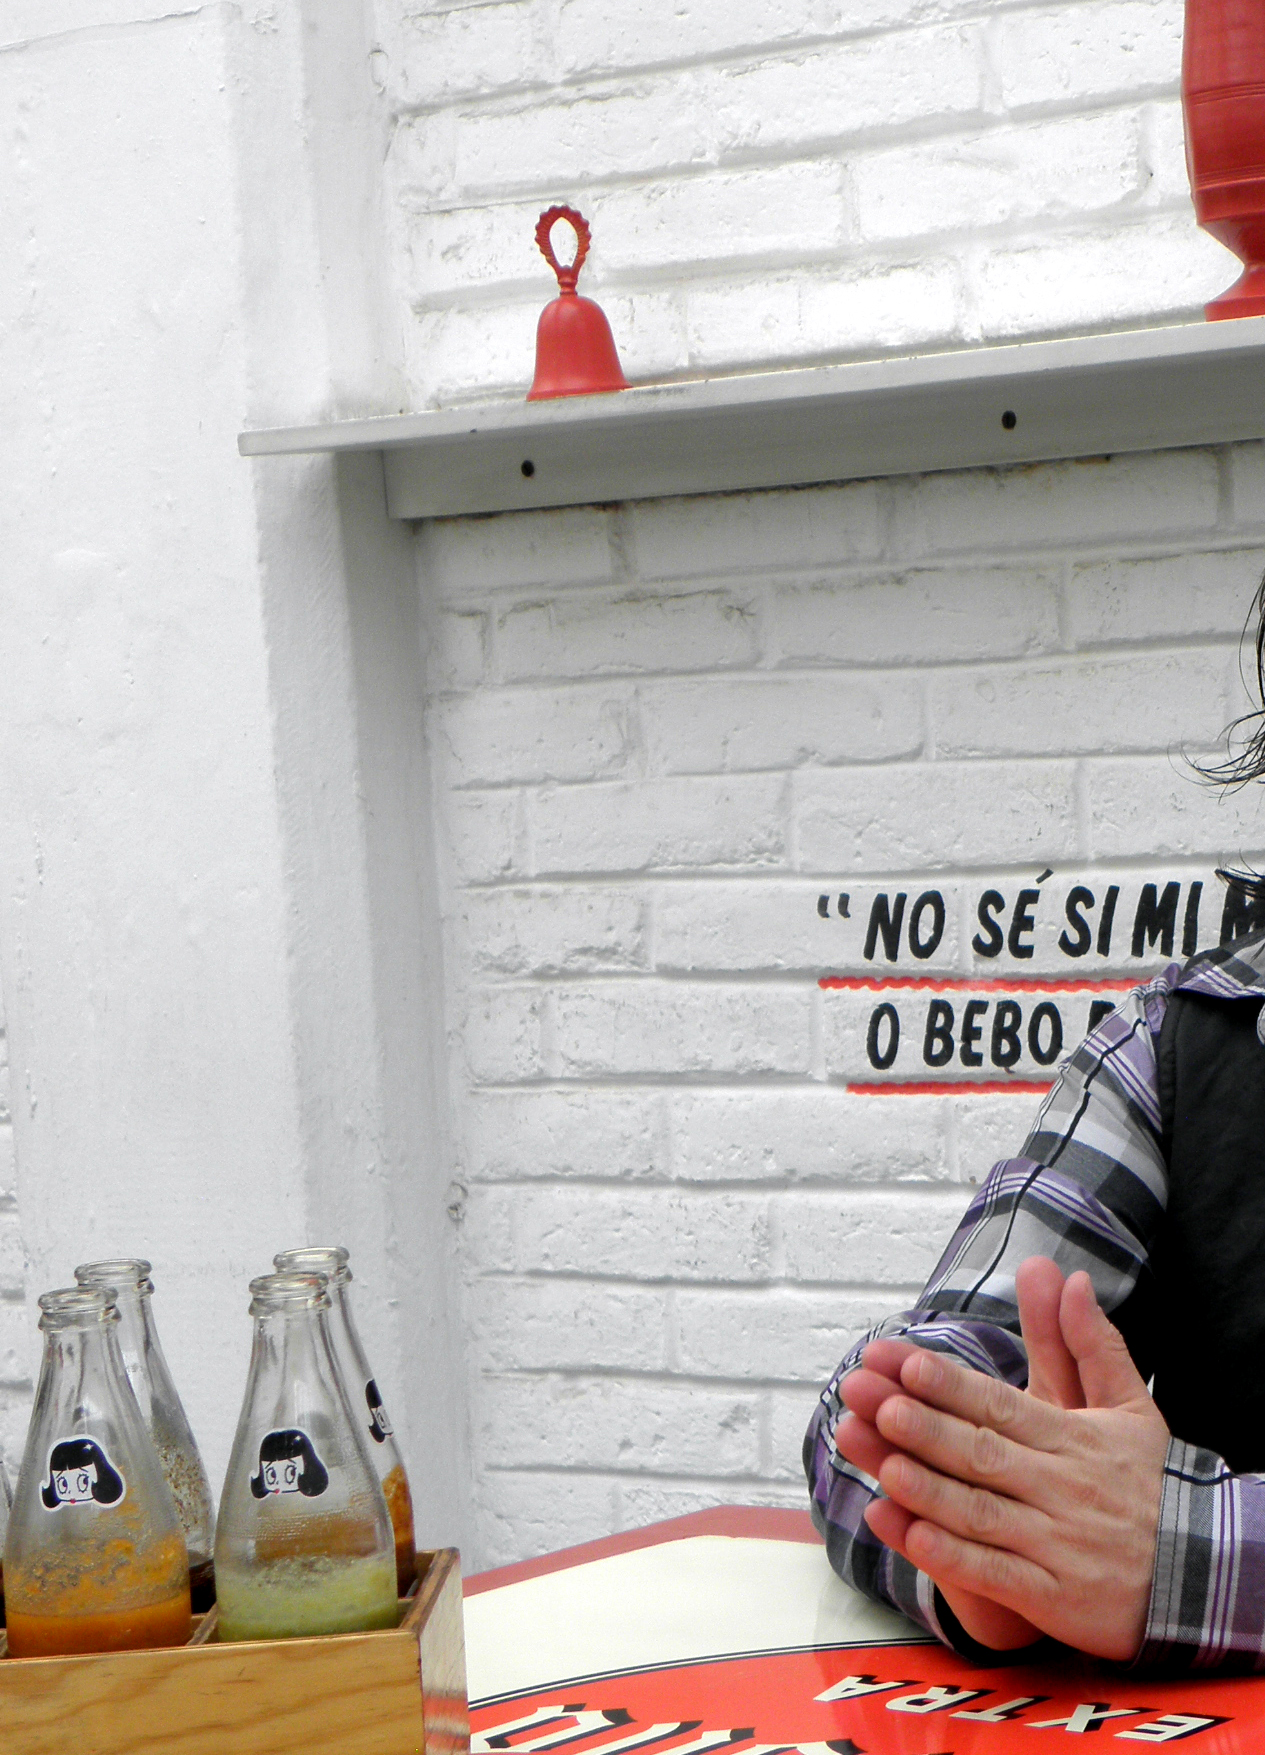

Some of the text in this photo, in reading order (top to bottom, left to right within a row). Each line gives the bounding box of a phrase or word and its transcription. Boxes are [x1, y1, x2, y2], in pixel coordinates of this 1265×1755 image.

[971, 868, 1054, 959] SÉ
[1057, 885, 1120, 959] SI
[1131, 881, 1204, 958] MI
[866, 1001, 900, 1070] O
[922, 999, 1064, 1068] BEBO
[813, 1675, 1222, 1742] EXTRA
